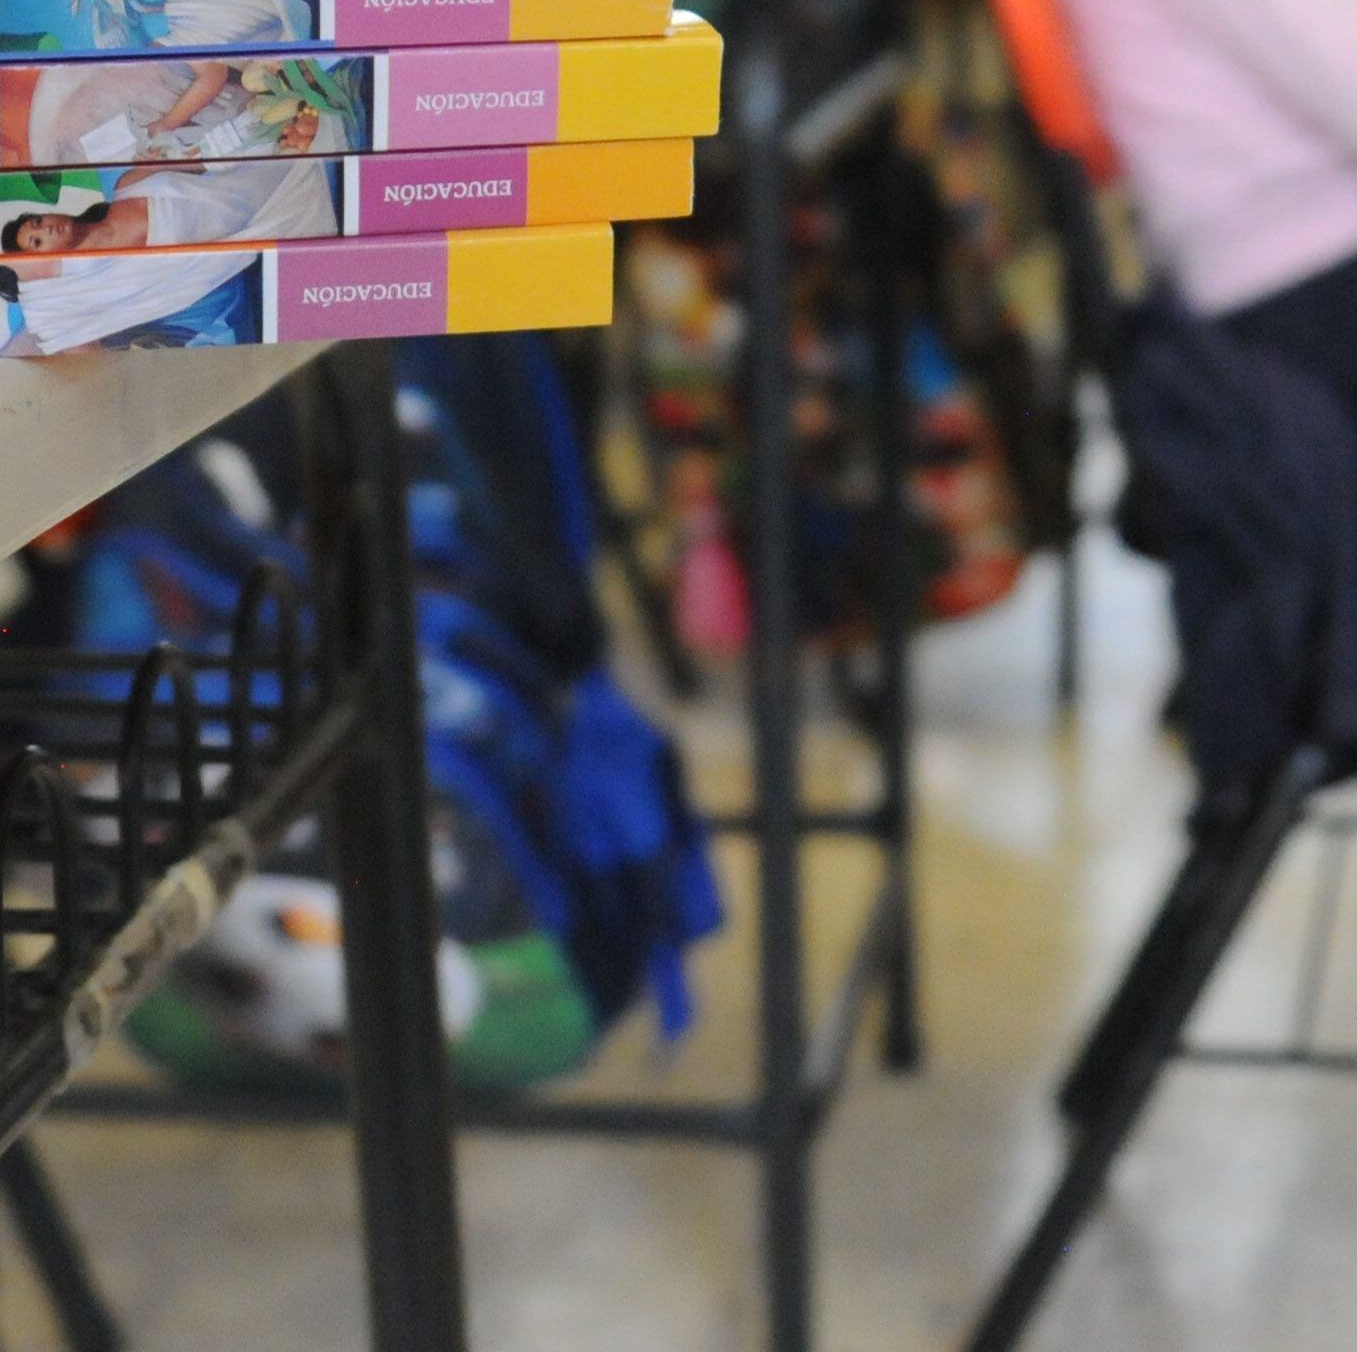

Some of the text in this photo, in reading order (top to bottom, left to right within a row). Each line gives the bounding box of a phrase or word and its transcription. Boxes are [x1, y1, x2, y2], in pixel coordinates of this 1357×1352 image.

[416, 90, 544, 115] EDUCACIÓN
[384, 180, 512, 205] EDUCACIÓN
[303, 282, 432, 307] EDUCACIÓN
